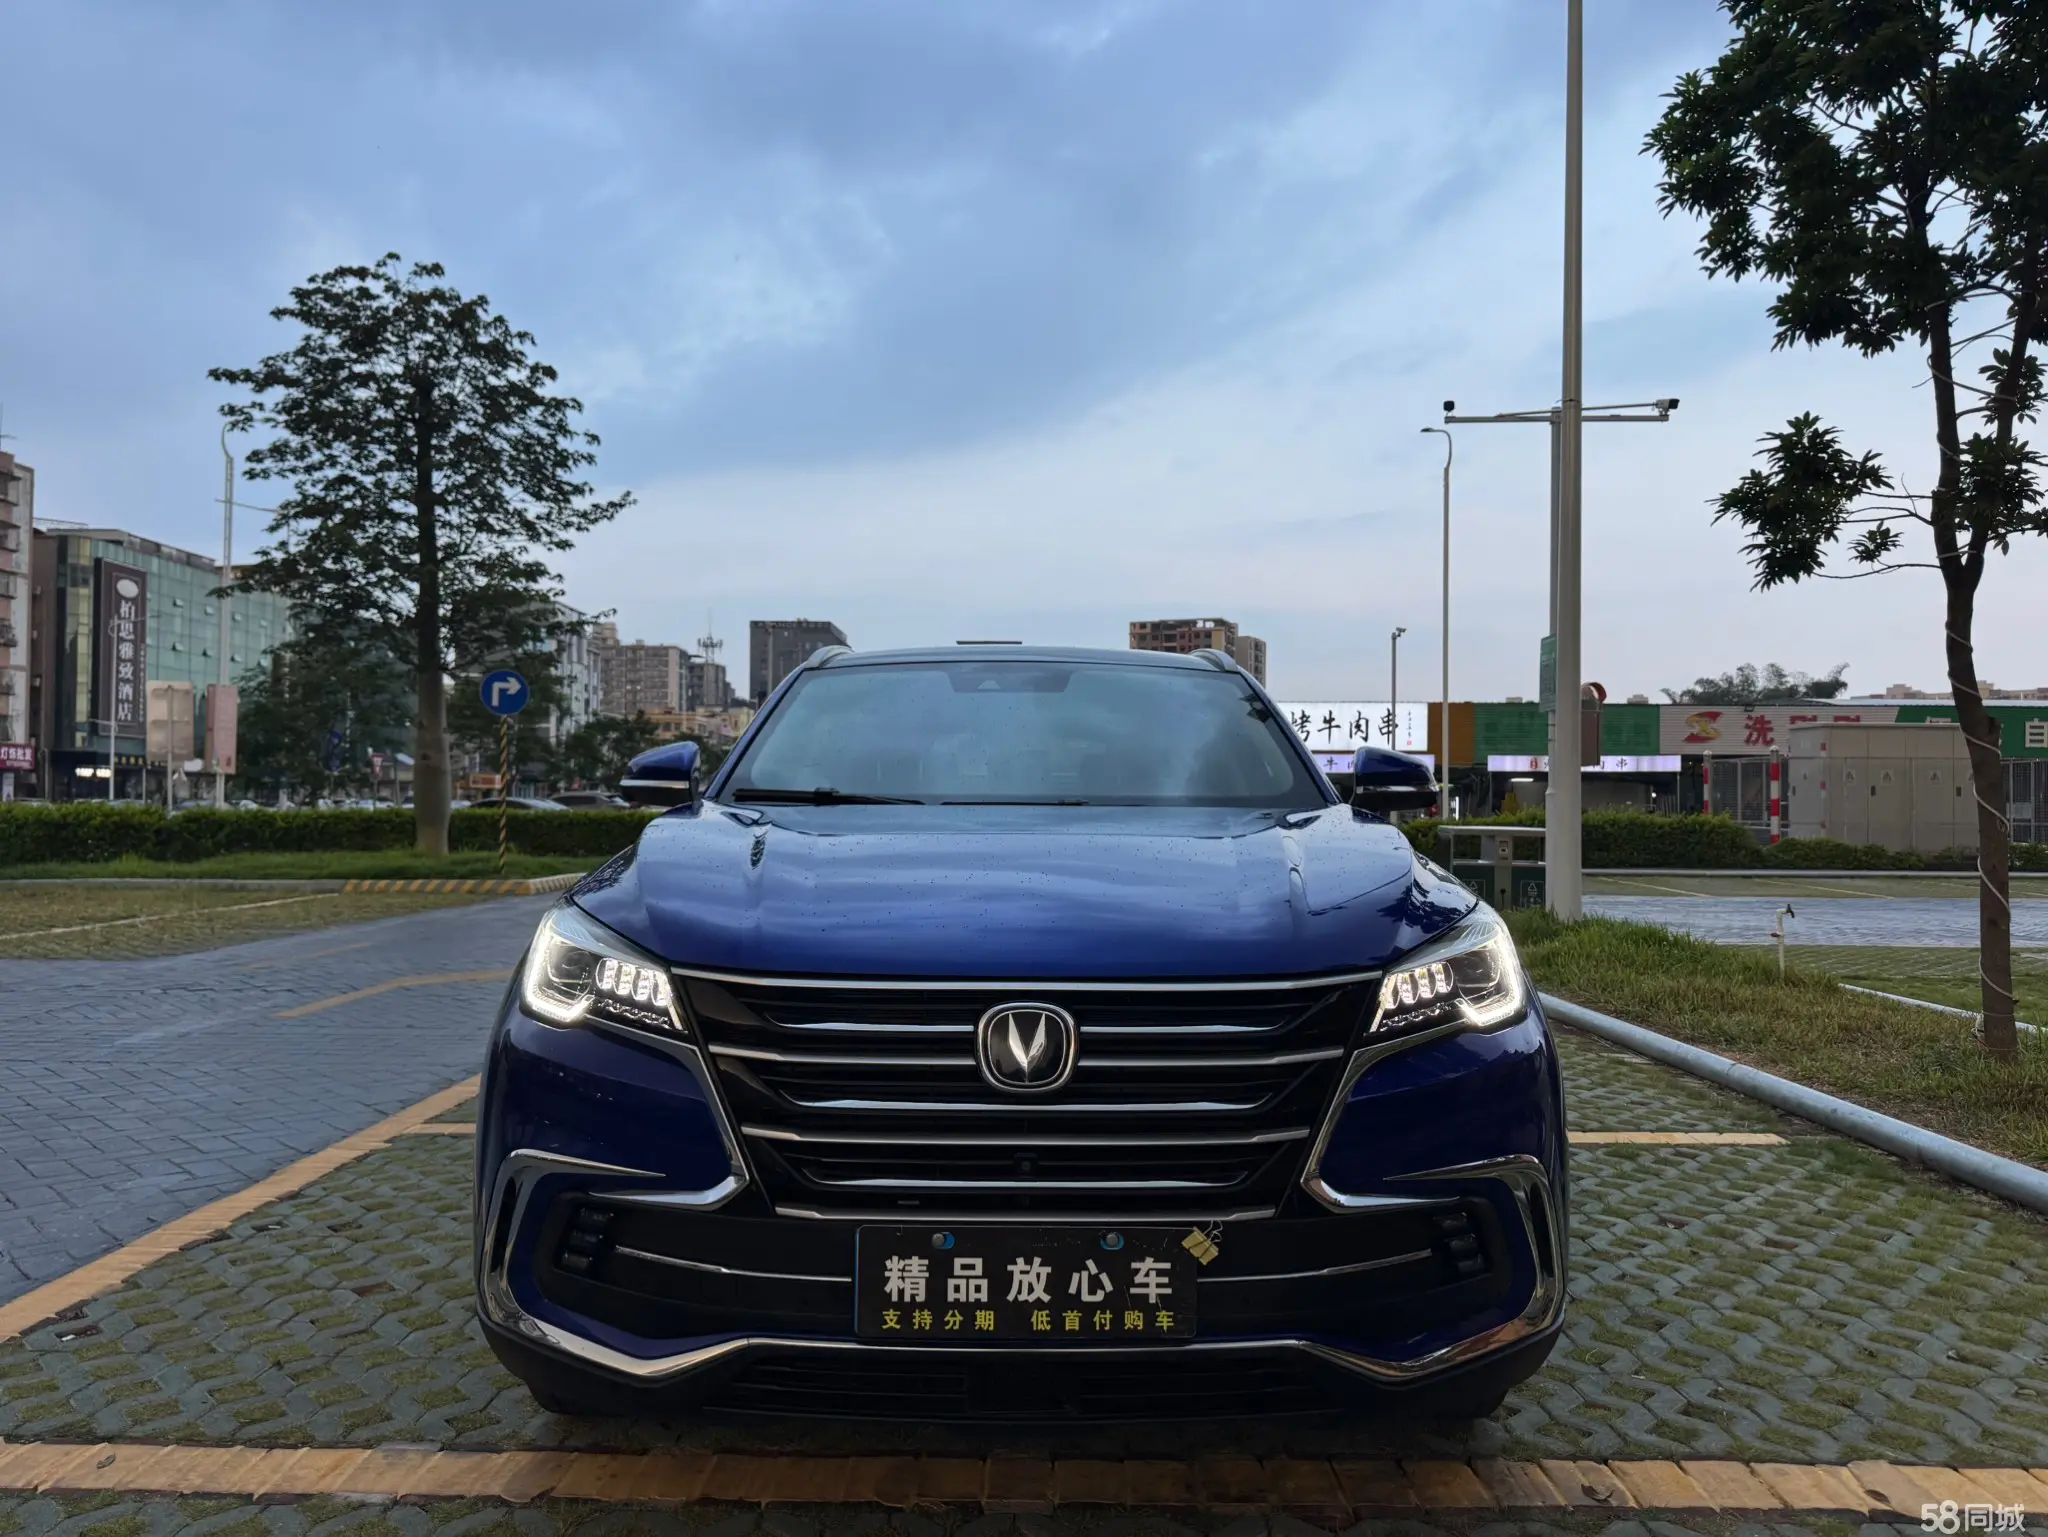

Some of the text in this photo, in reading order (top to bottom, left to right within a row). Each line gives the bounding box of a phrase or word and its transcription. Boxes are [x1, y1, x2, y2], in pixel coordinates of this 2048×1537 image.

[884, 1256, 1173, 1304] 精品放心车
[881, 1309, 1175, 1332] 支持分期 低首付购车
